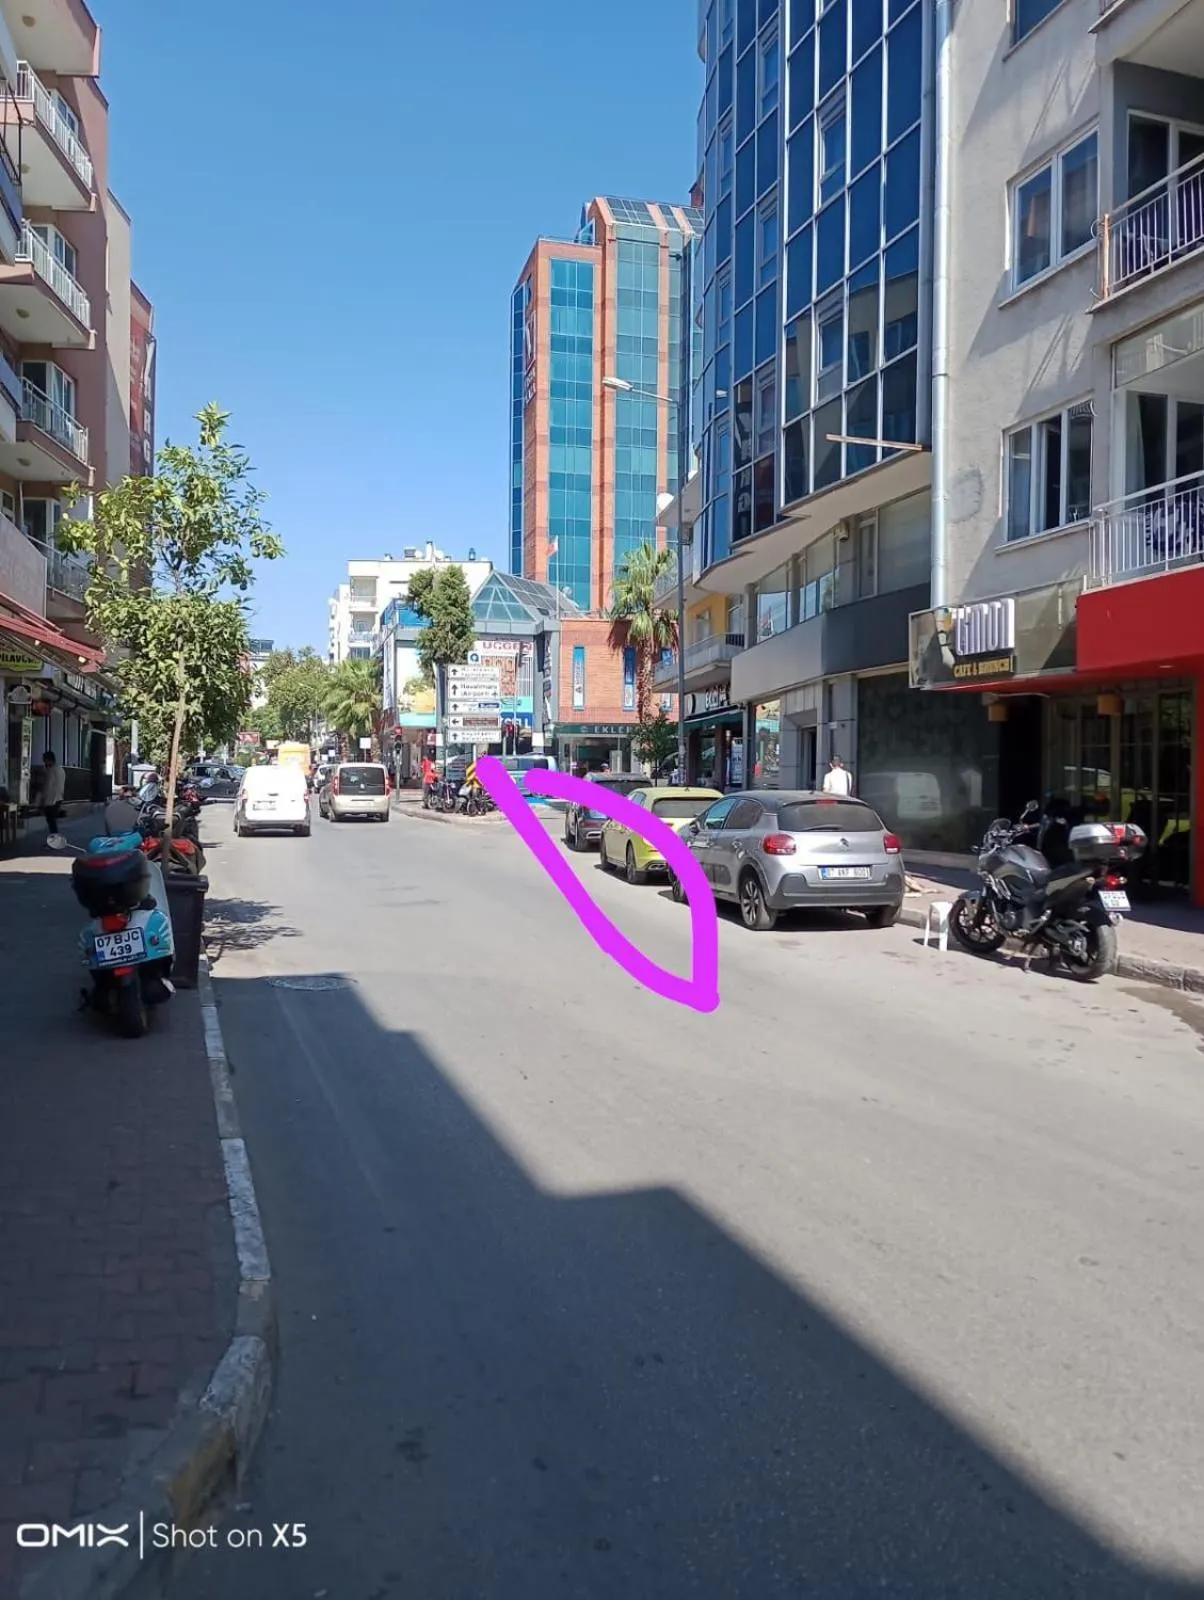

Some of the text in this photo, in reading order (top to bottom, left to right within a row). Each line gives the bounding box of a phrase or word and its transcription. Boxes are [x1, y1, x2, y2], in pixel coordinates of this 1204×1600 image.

[143, 342, 155, 476] YARG
[97, 931, 139, 948] 07 BJC
[110, 944, 132, 956] 439
